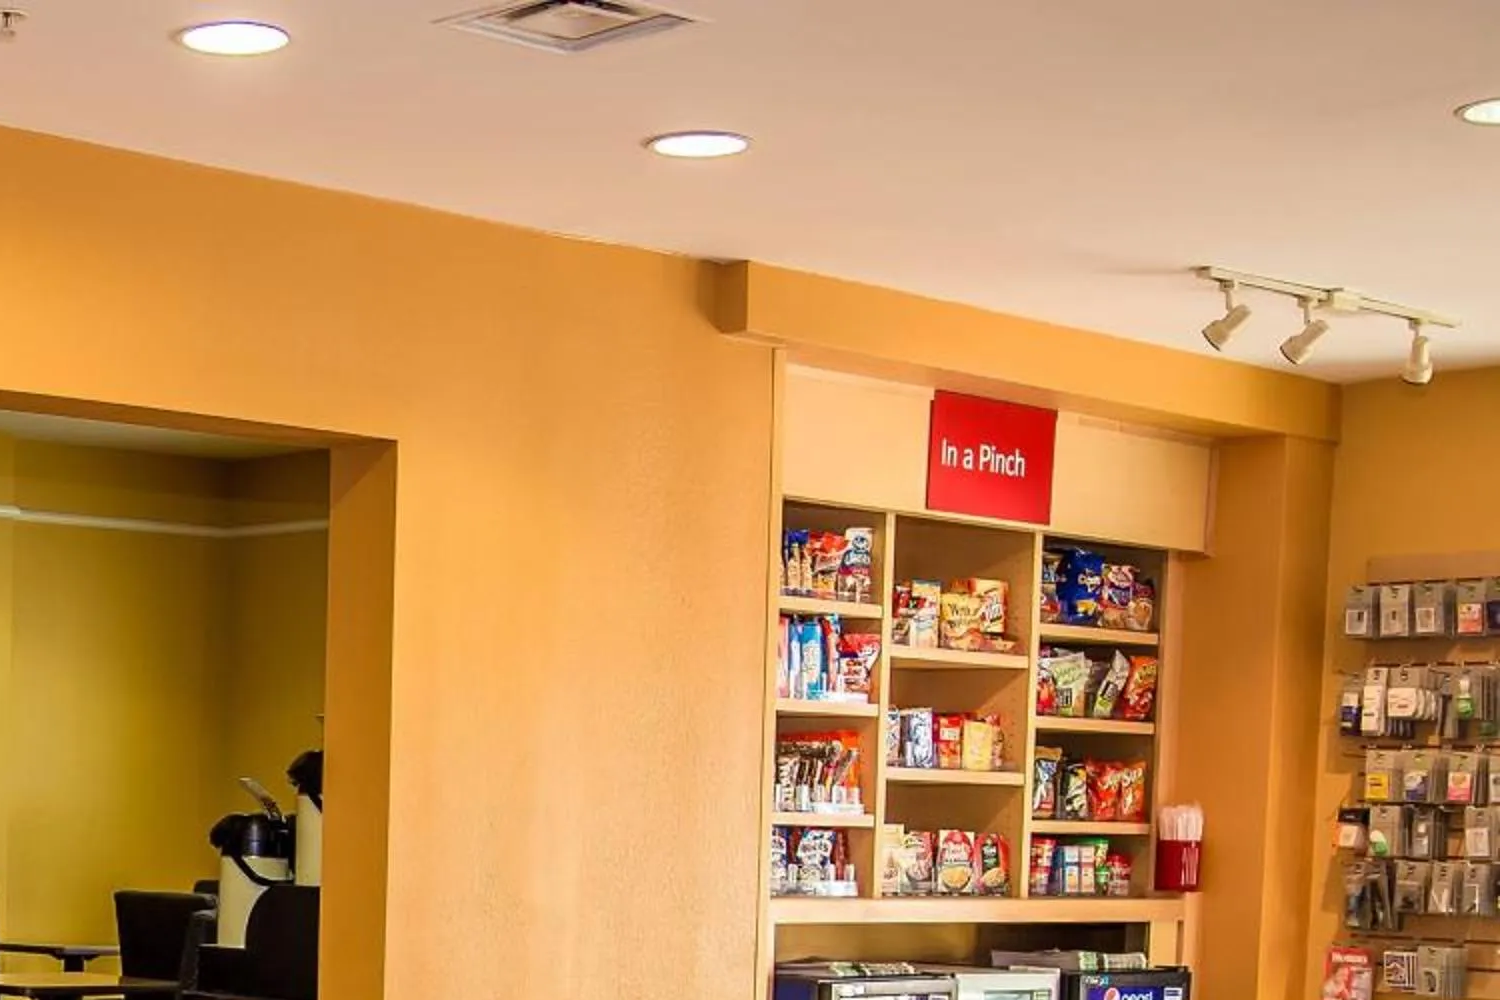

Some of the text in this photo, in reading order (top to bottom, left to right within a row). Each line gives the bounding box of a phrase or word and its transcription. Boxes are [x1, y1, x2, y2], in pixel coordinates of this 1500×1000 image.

[941, 437, 1026, 478] In a Pinch
